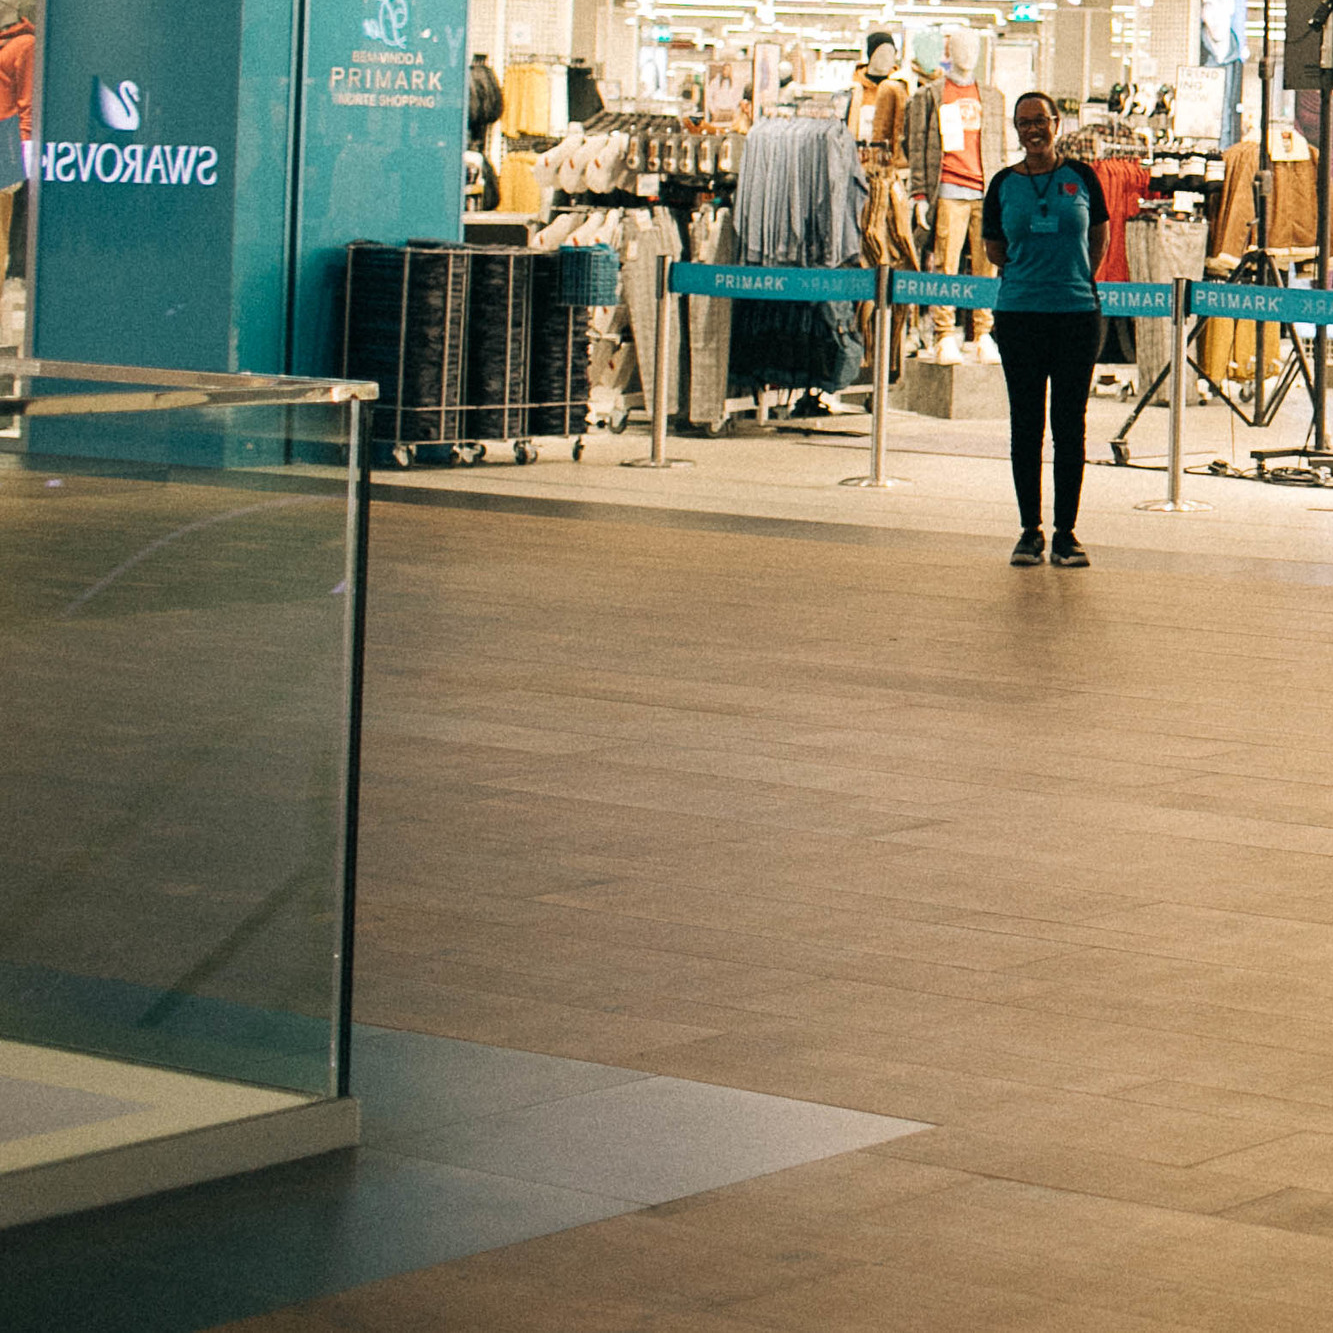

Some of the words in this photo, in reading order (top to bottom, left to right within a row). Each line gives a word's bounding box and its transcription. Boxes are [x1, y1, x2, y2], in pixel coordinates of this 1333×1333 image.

[330, 66, 443, 92] PRIMARK
[379, 94, 435, 109] SHOPPING
[714, 272, 785, 292] PRIMARK
[896, 279, 974, 299] PRIMARK
[1196, 290, 1280, 312] PRIMARK
